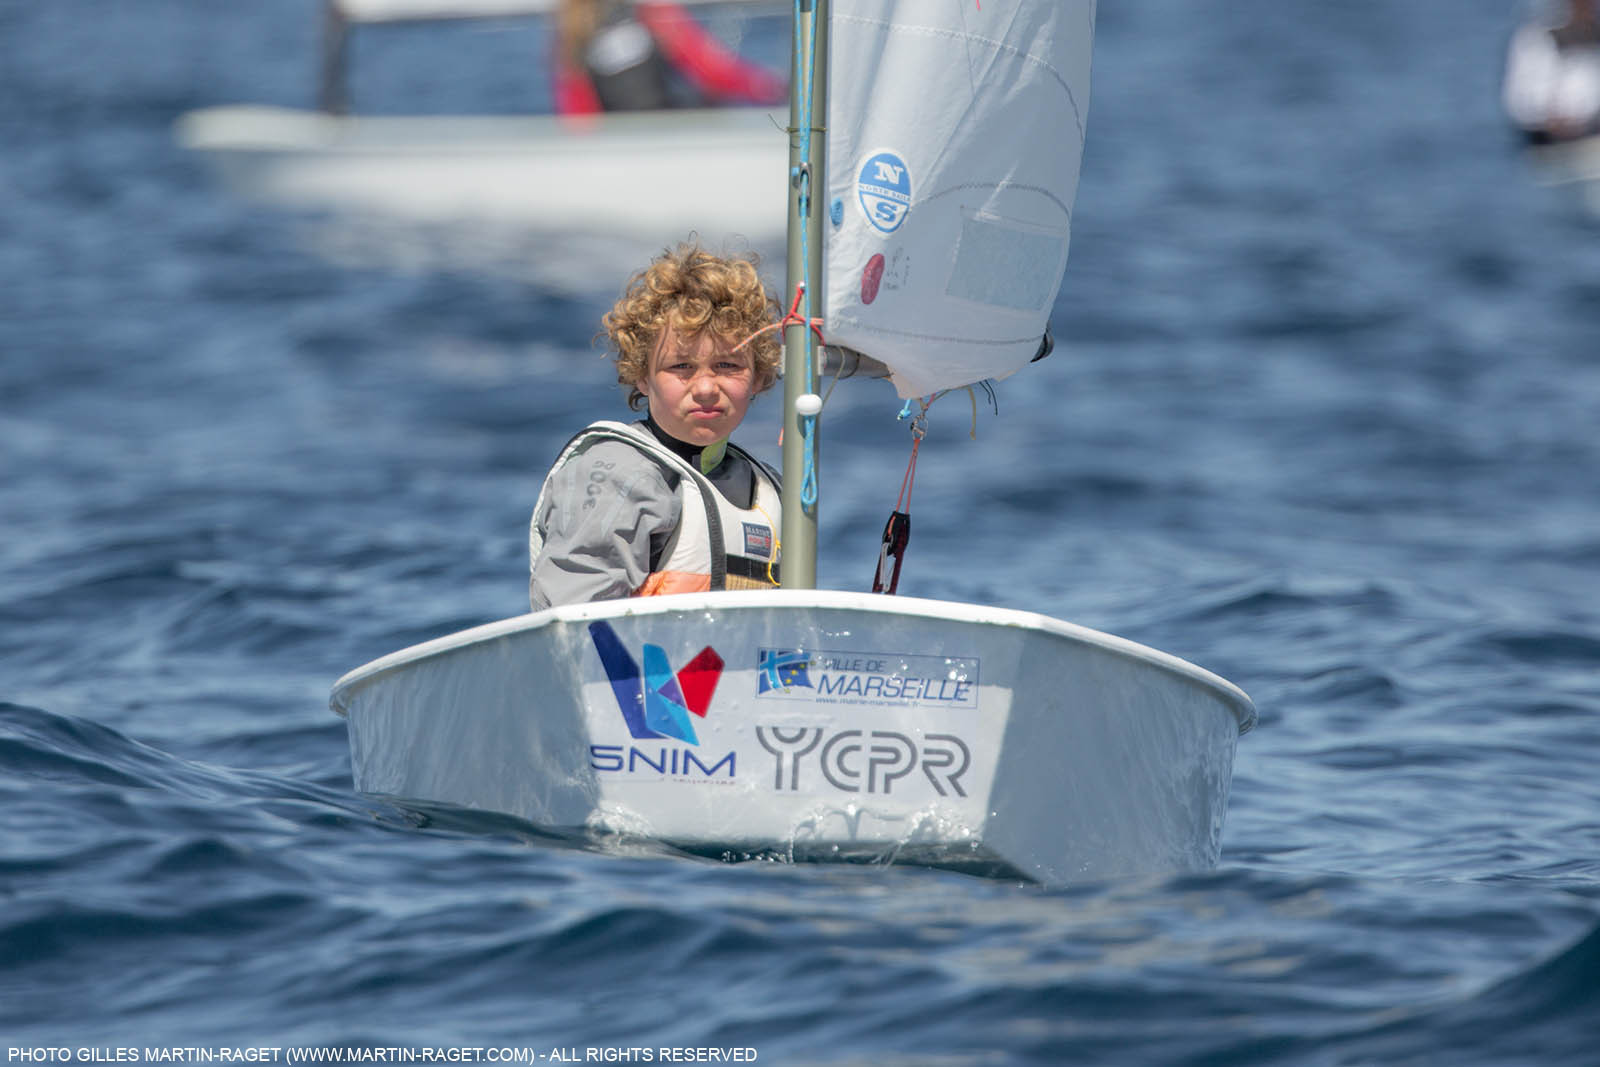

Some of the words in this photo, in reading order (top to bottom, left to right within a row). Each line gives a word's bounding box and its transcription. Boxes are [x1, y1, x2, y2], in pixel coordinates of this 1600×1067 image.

[874, 161, 904, 185] N
[876, 202, 897, 222] S
[865, 660, 887, 672] DE
[590, 745, 736, 777] SNIM
[756, 725, 971, 798] YCPR
